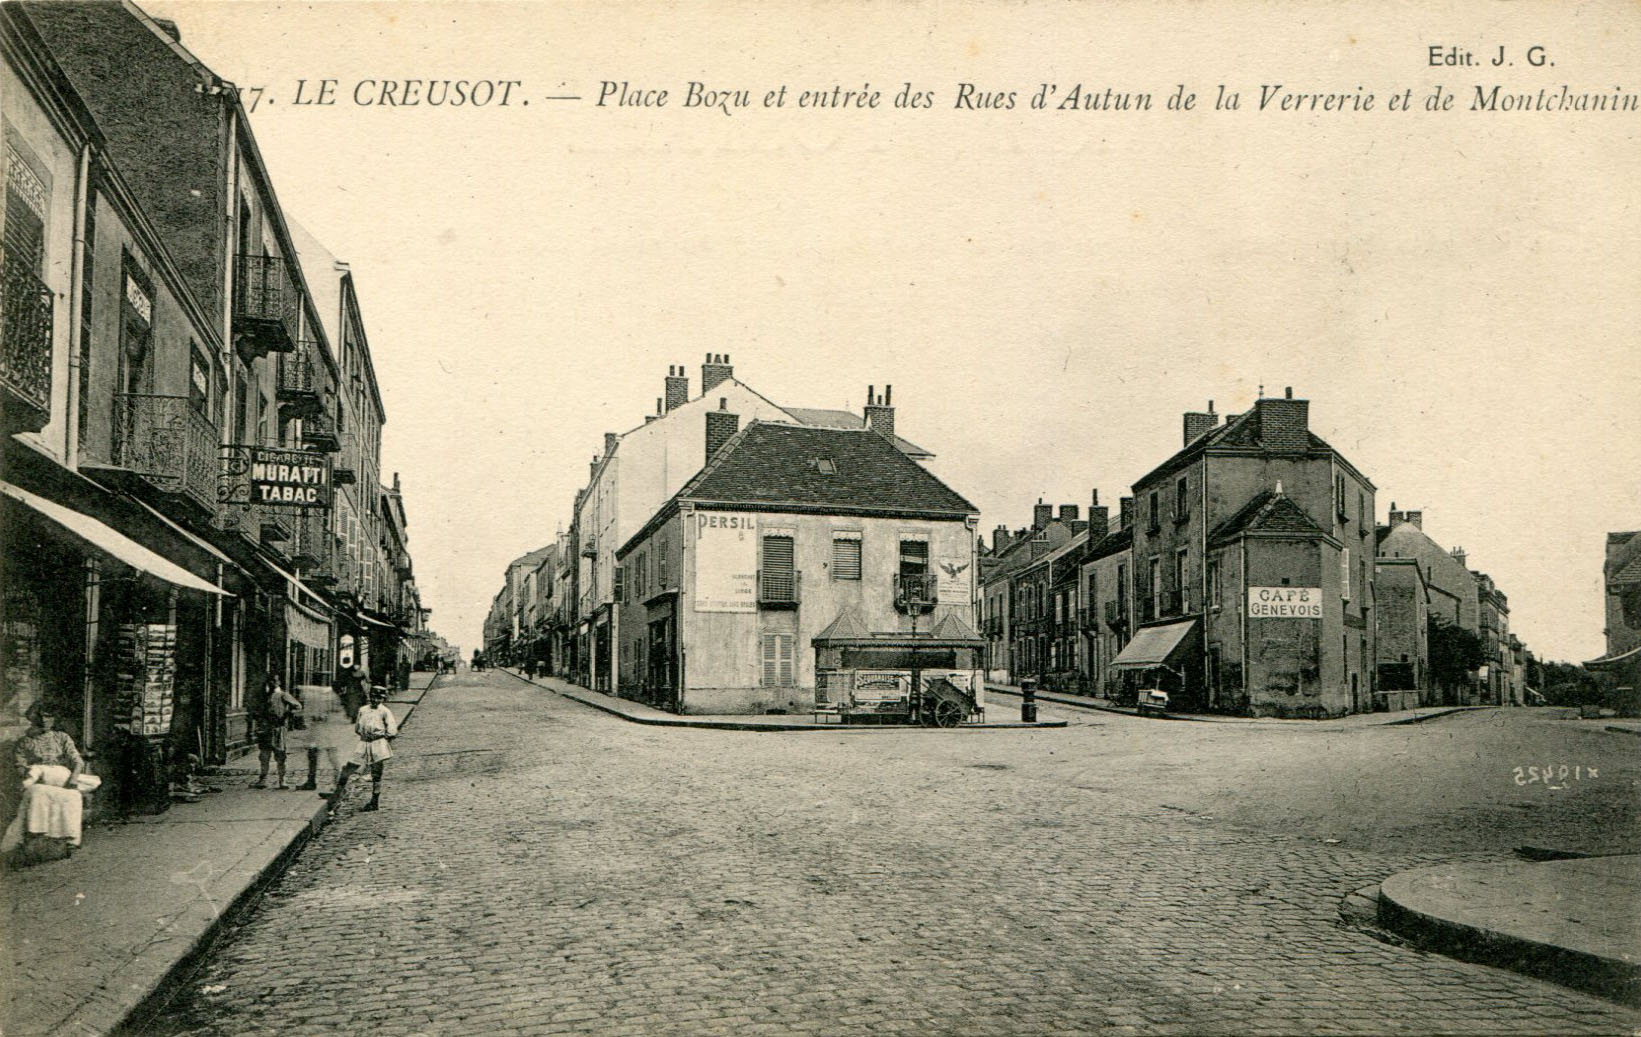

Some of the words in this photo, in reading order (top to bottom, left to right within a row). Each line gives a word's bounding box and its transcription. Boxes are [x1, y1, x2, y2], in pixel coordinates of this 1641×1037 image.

[252, 463, 327, 484] MURATTI
[259, 485, 317, 502] TABAC
[1251, 603, 1320, 615] GENEVOIS
